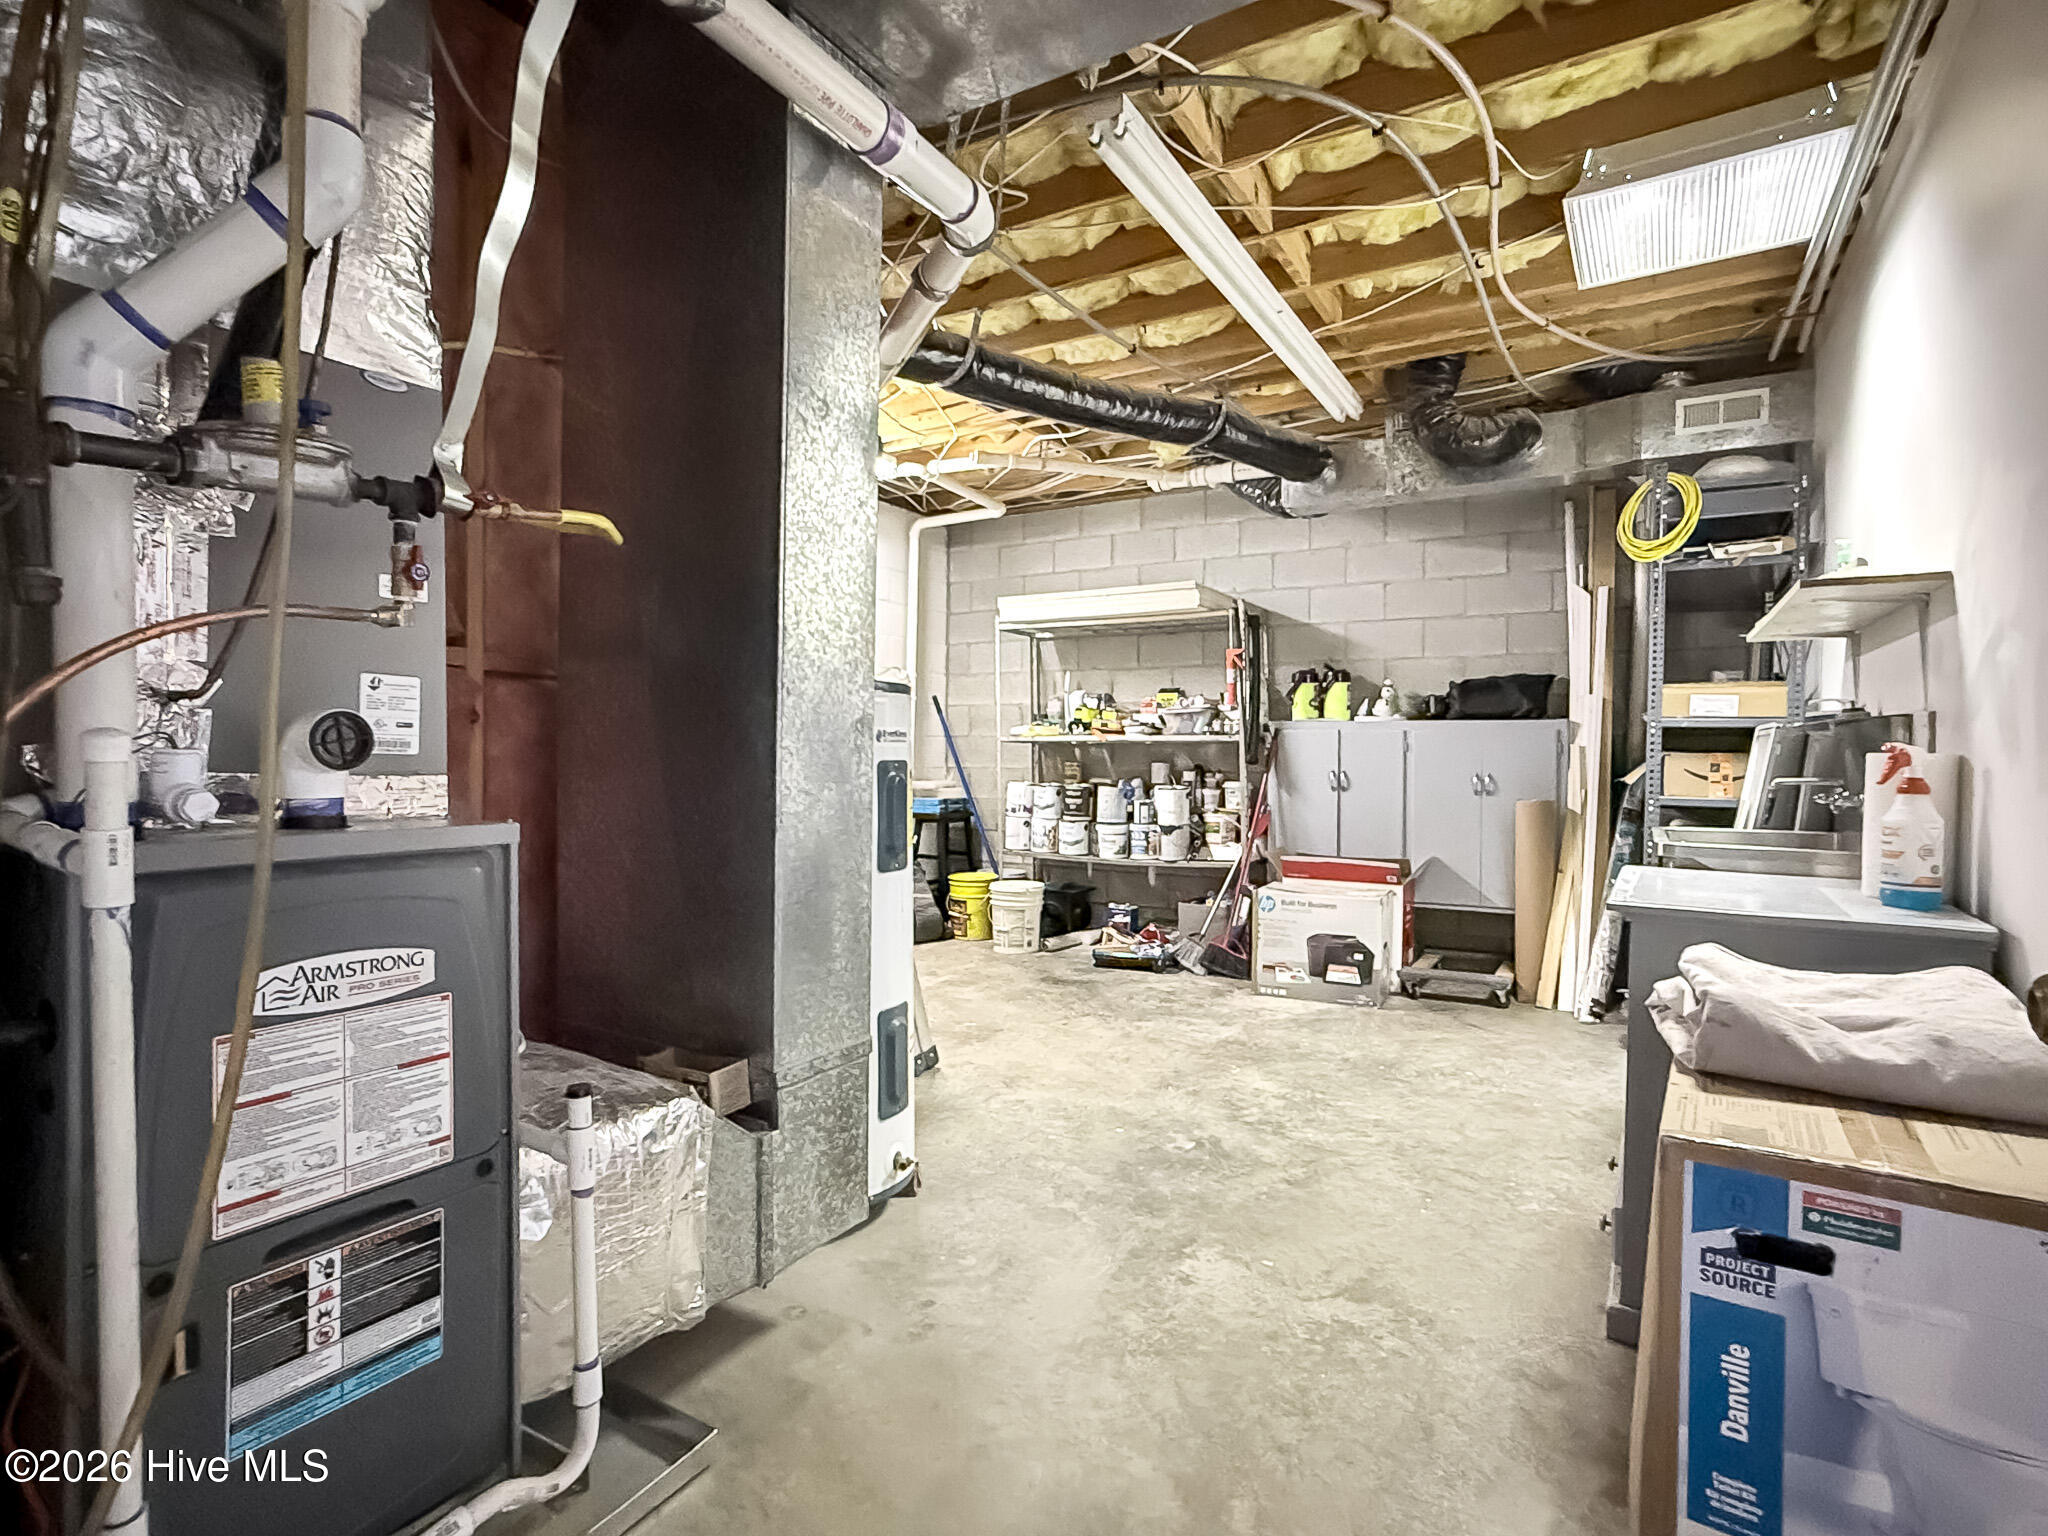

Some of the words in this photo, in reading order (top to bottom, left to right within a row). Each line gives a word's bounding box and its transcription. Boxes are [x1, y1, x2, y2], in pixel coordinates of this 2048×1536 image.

[289, 950, 425, 987] ARMSTRONG
[300, 984, 341, 1006] AIR
[349, 981, 376, 994] PRO
[378, 974, 421, 989] SERIES
[1704, 1252, 1771, 1278] PROJECT
[1699, 1268, 1776, 1299] SOURCE
[1720, 1343, 1751, 1443] Danville
